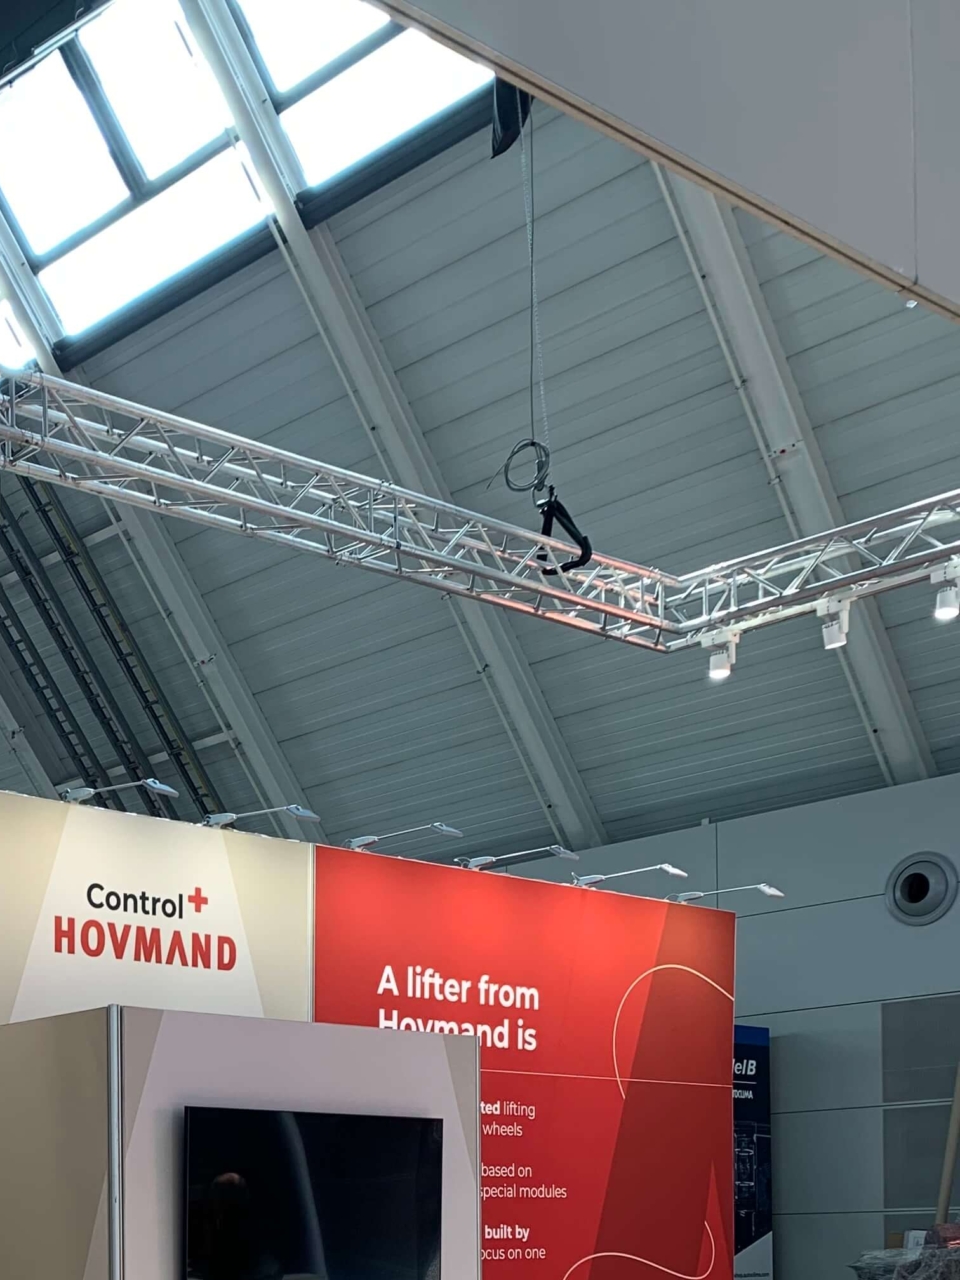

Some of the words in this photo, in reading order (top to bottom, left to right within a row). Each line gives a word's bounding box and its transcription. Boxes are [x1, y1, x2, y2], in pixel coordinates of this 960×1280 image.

[54, 915, 237, 971] HOVMAND
[377, 965, 399, 996] A
[407, 965, 472, 1003] lifter
[478, 974, 539, 1010] from
[517, 1018, 538, 1051] is
[503, 1101, 536, 1120] lifting
[482, 1121, 523, 1137] wheels
[481, 1162, 515, 1177] based
[517, 1166, 532, 1178] on
[519, 1184, 567, 1198] modules
[484, 1224, 513, 1239] built
[515, 1225, 530, 1242] by
[507, 1248, 522, 1260] on
[525, 1248, 547, 1260] one
